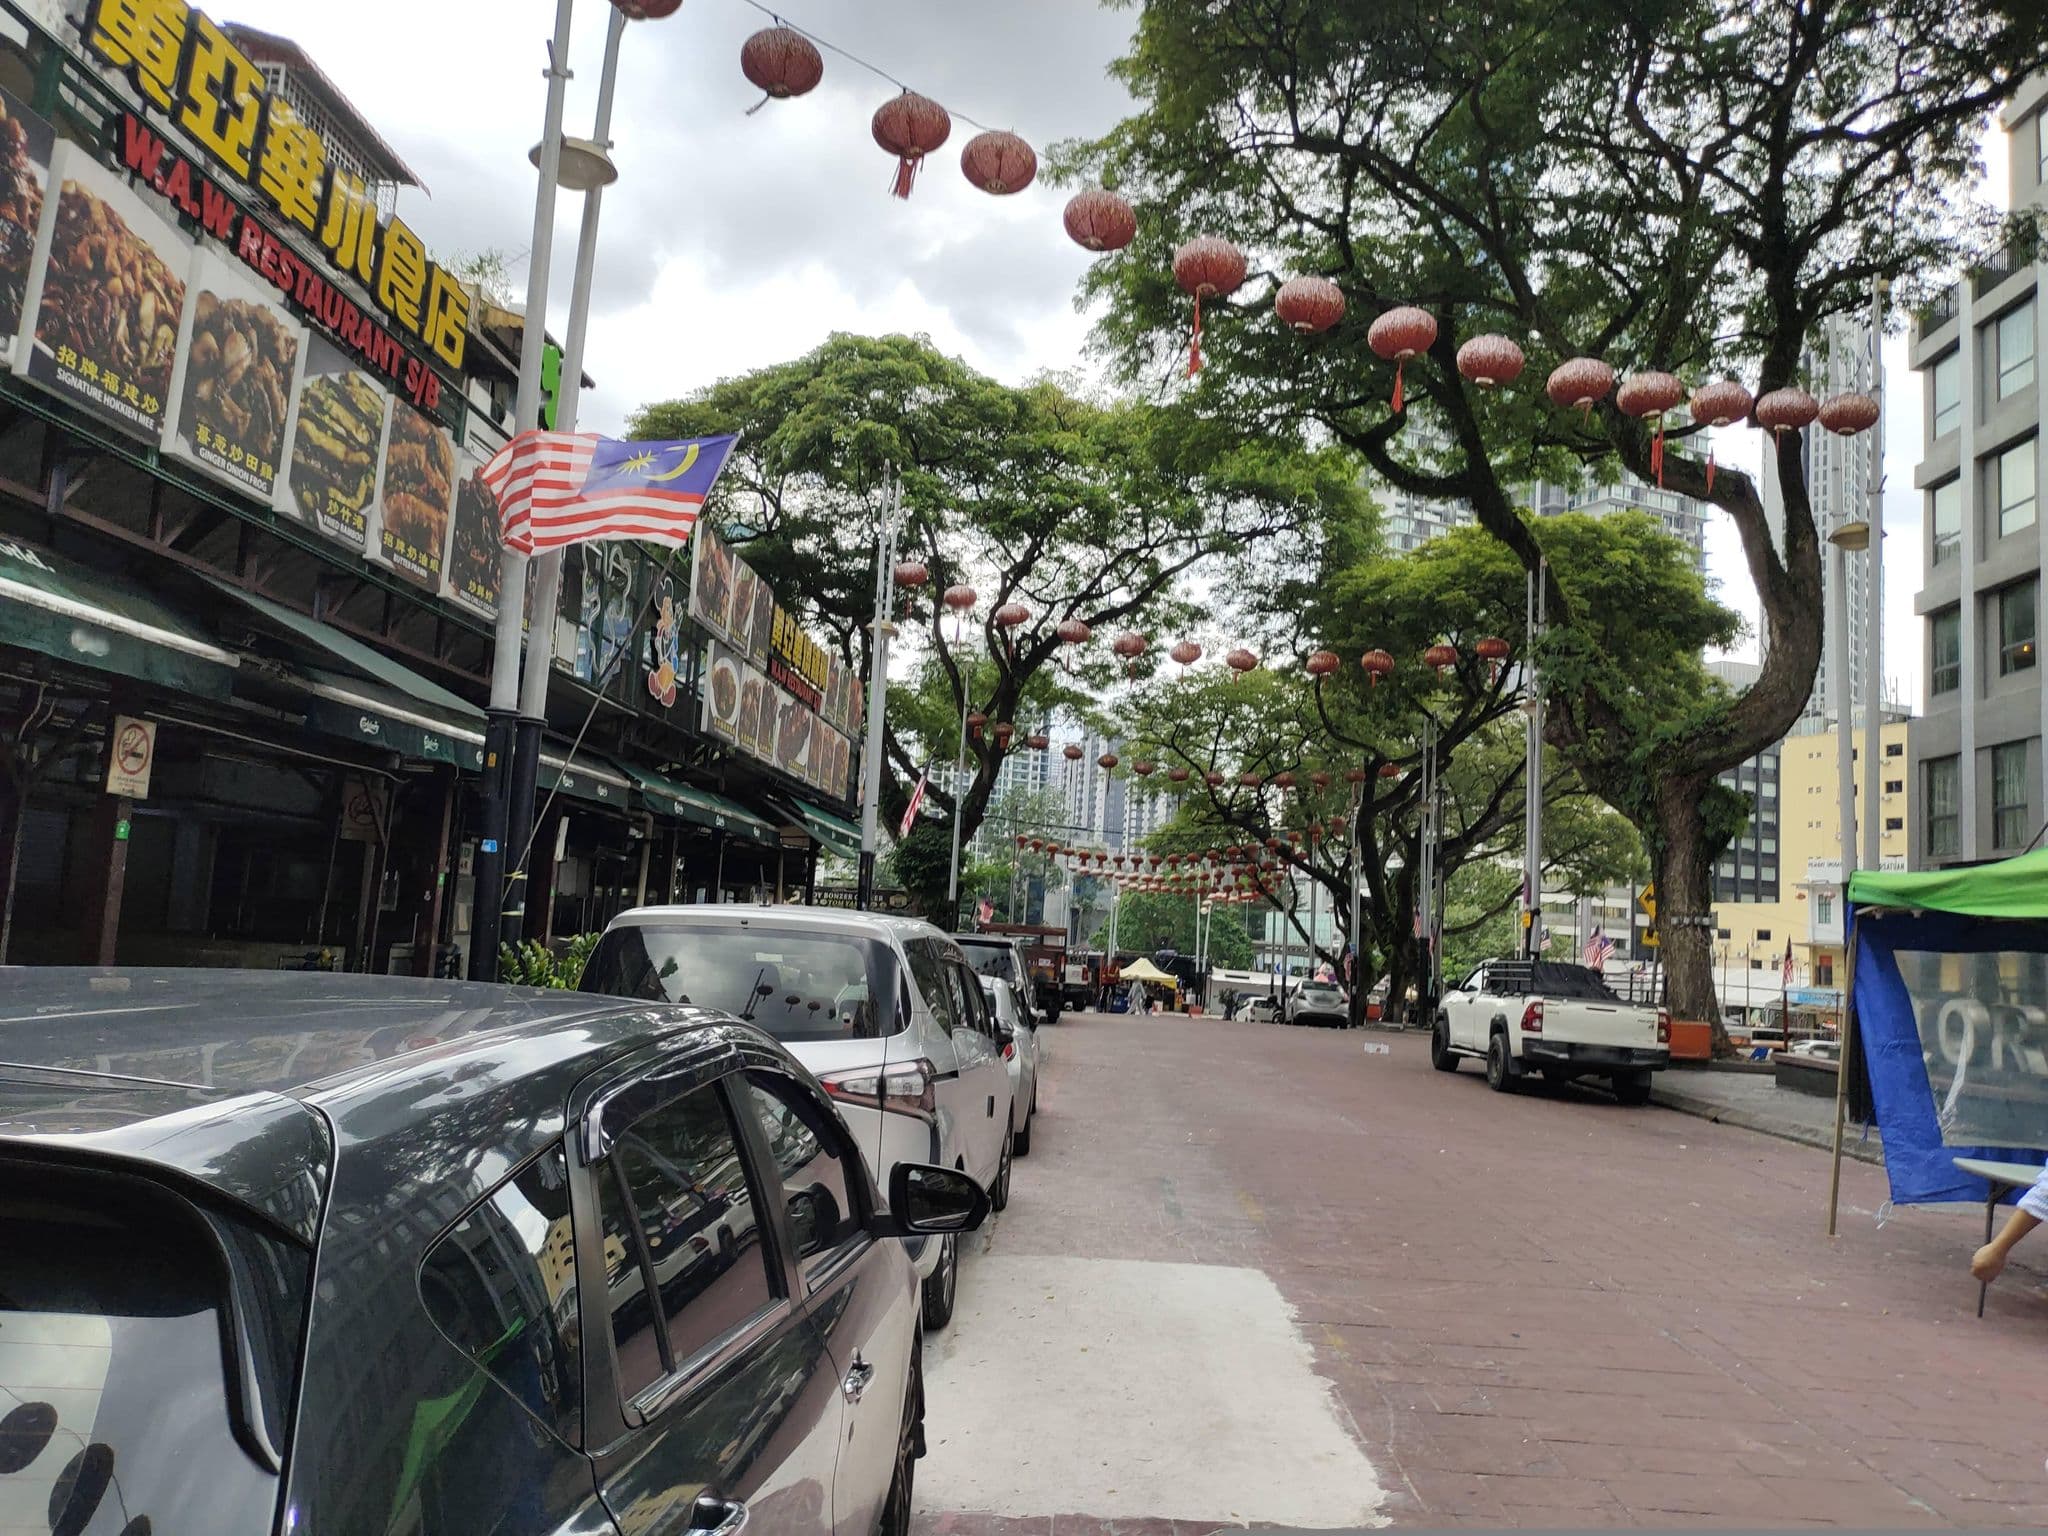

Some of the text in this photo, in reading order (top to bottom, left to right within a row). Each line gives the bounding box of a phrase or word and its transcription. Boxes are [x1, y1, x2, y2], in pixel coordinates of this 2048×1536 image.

[122, 113, 441, 409] W.A.W RESTAURANT S/B
[56, 367, 155, 431] SIGNATURE HOKKIEN MEE
[199, 447, 268, 492] GINGER ONION FROG
